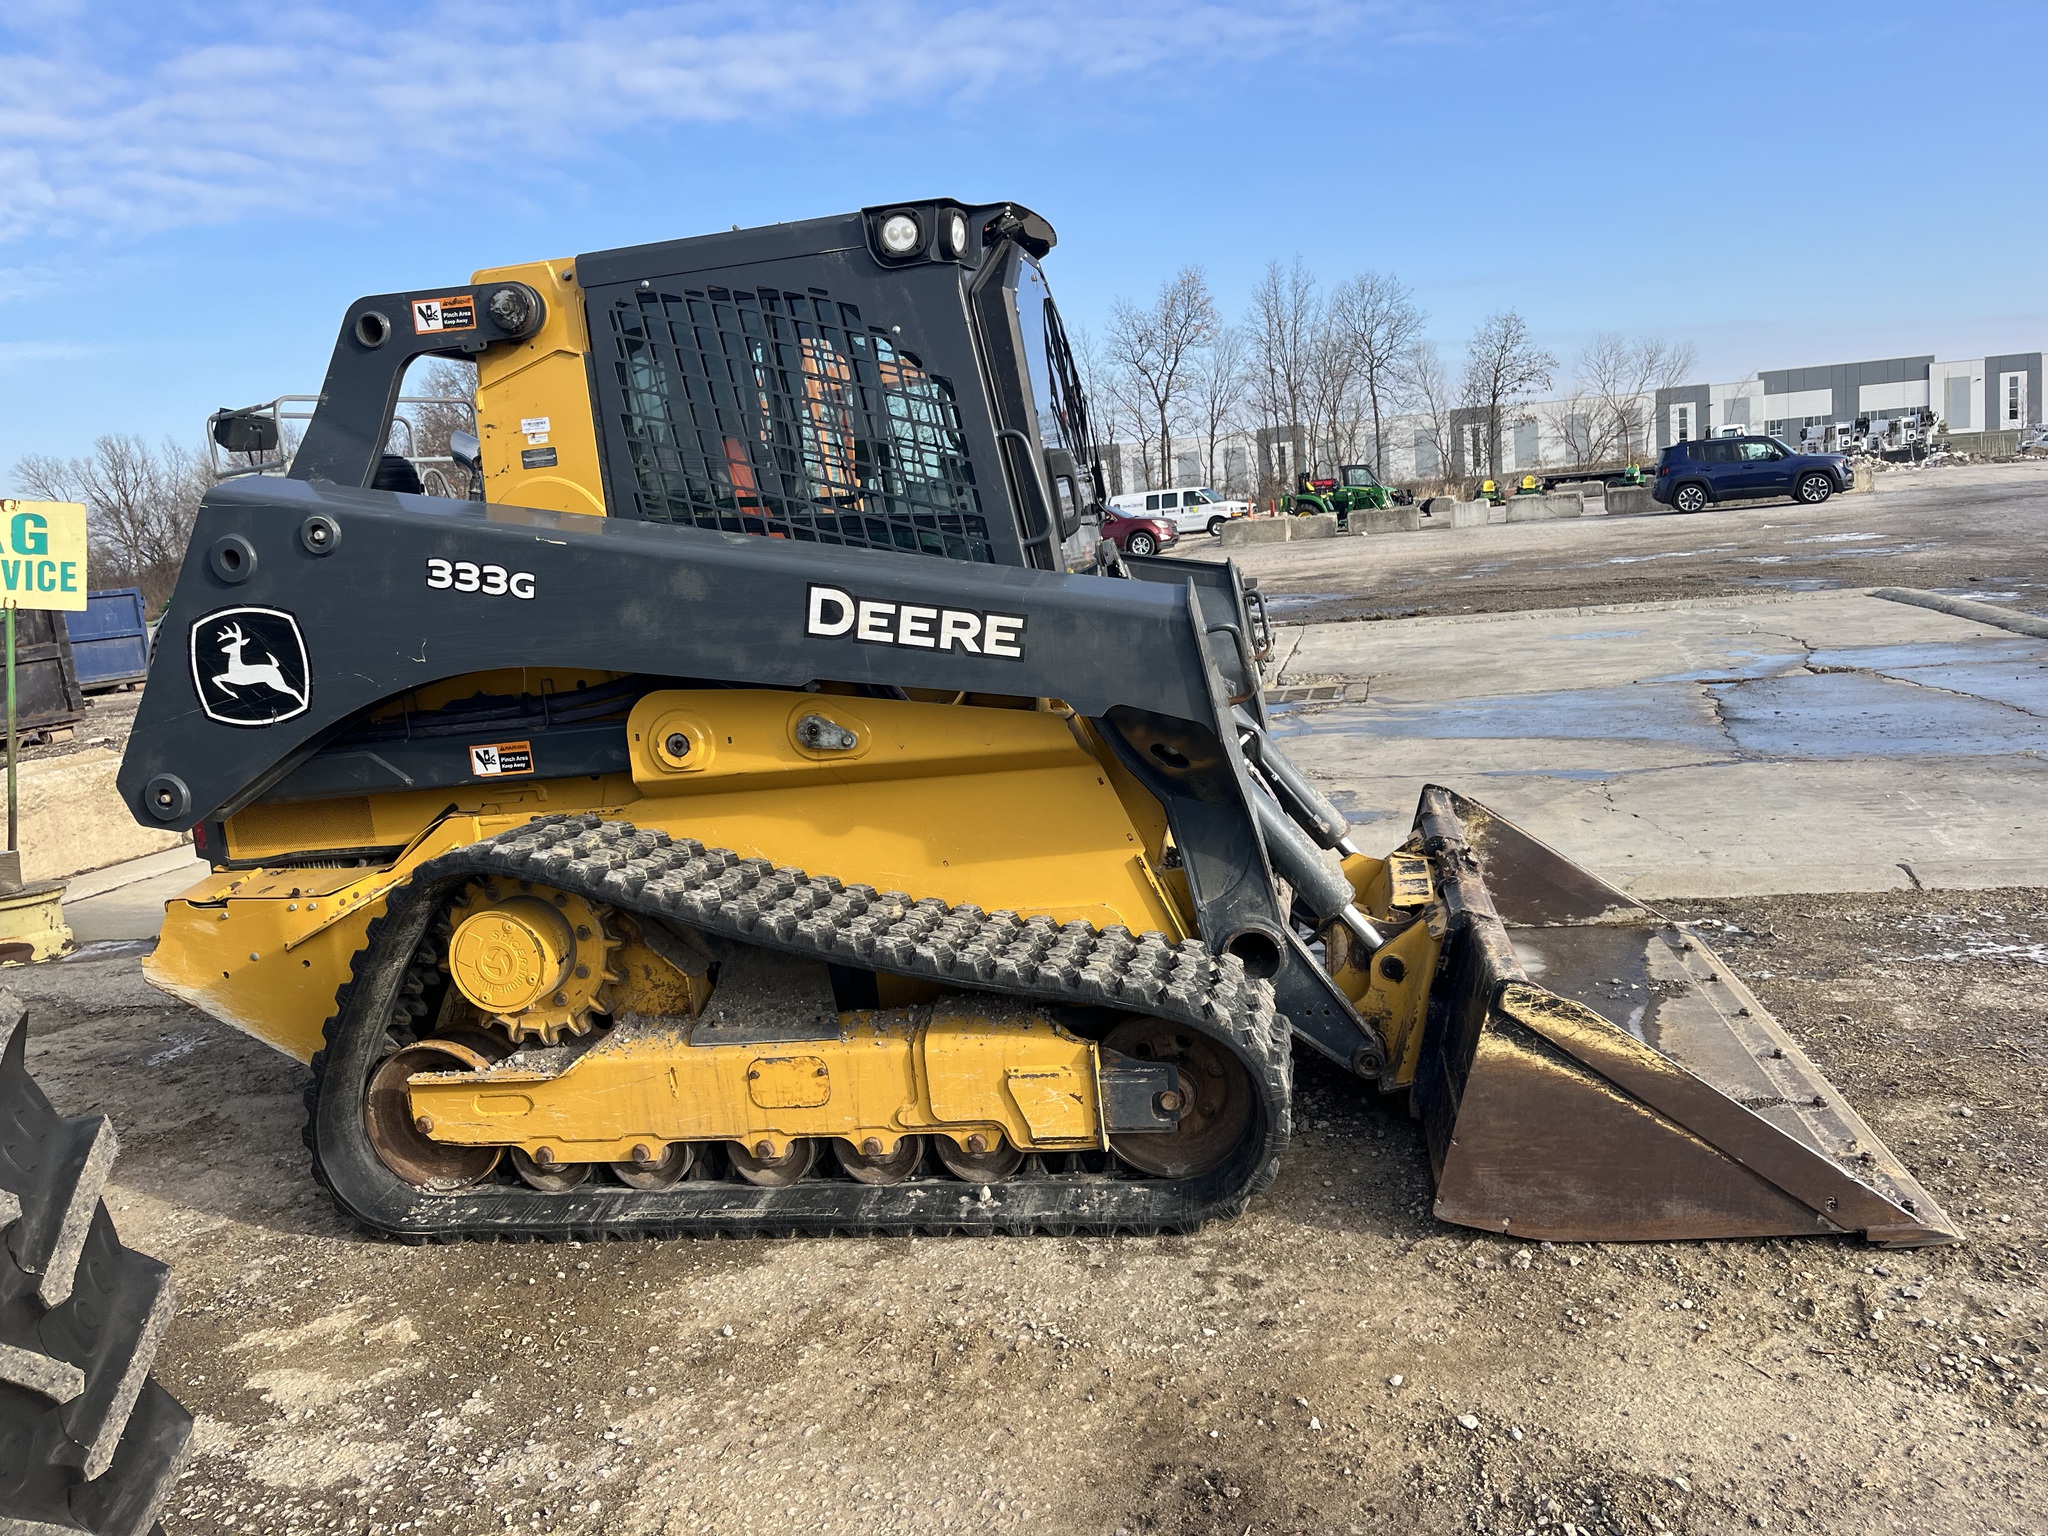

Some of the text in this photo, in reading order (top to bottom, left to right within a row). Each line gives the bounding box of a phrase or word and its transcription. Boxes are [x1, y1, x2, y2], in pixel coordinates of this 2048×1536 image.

[0, 513, 48, 555] G
[427, 558, 535, 599] 333G
[808, 586, 1024, 658] DEERE
[491, 930, 528, 967] SPICER
